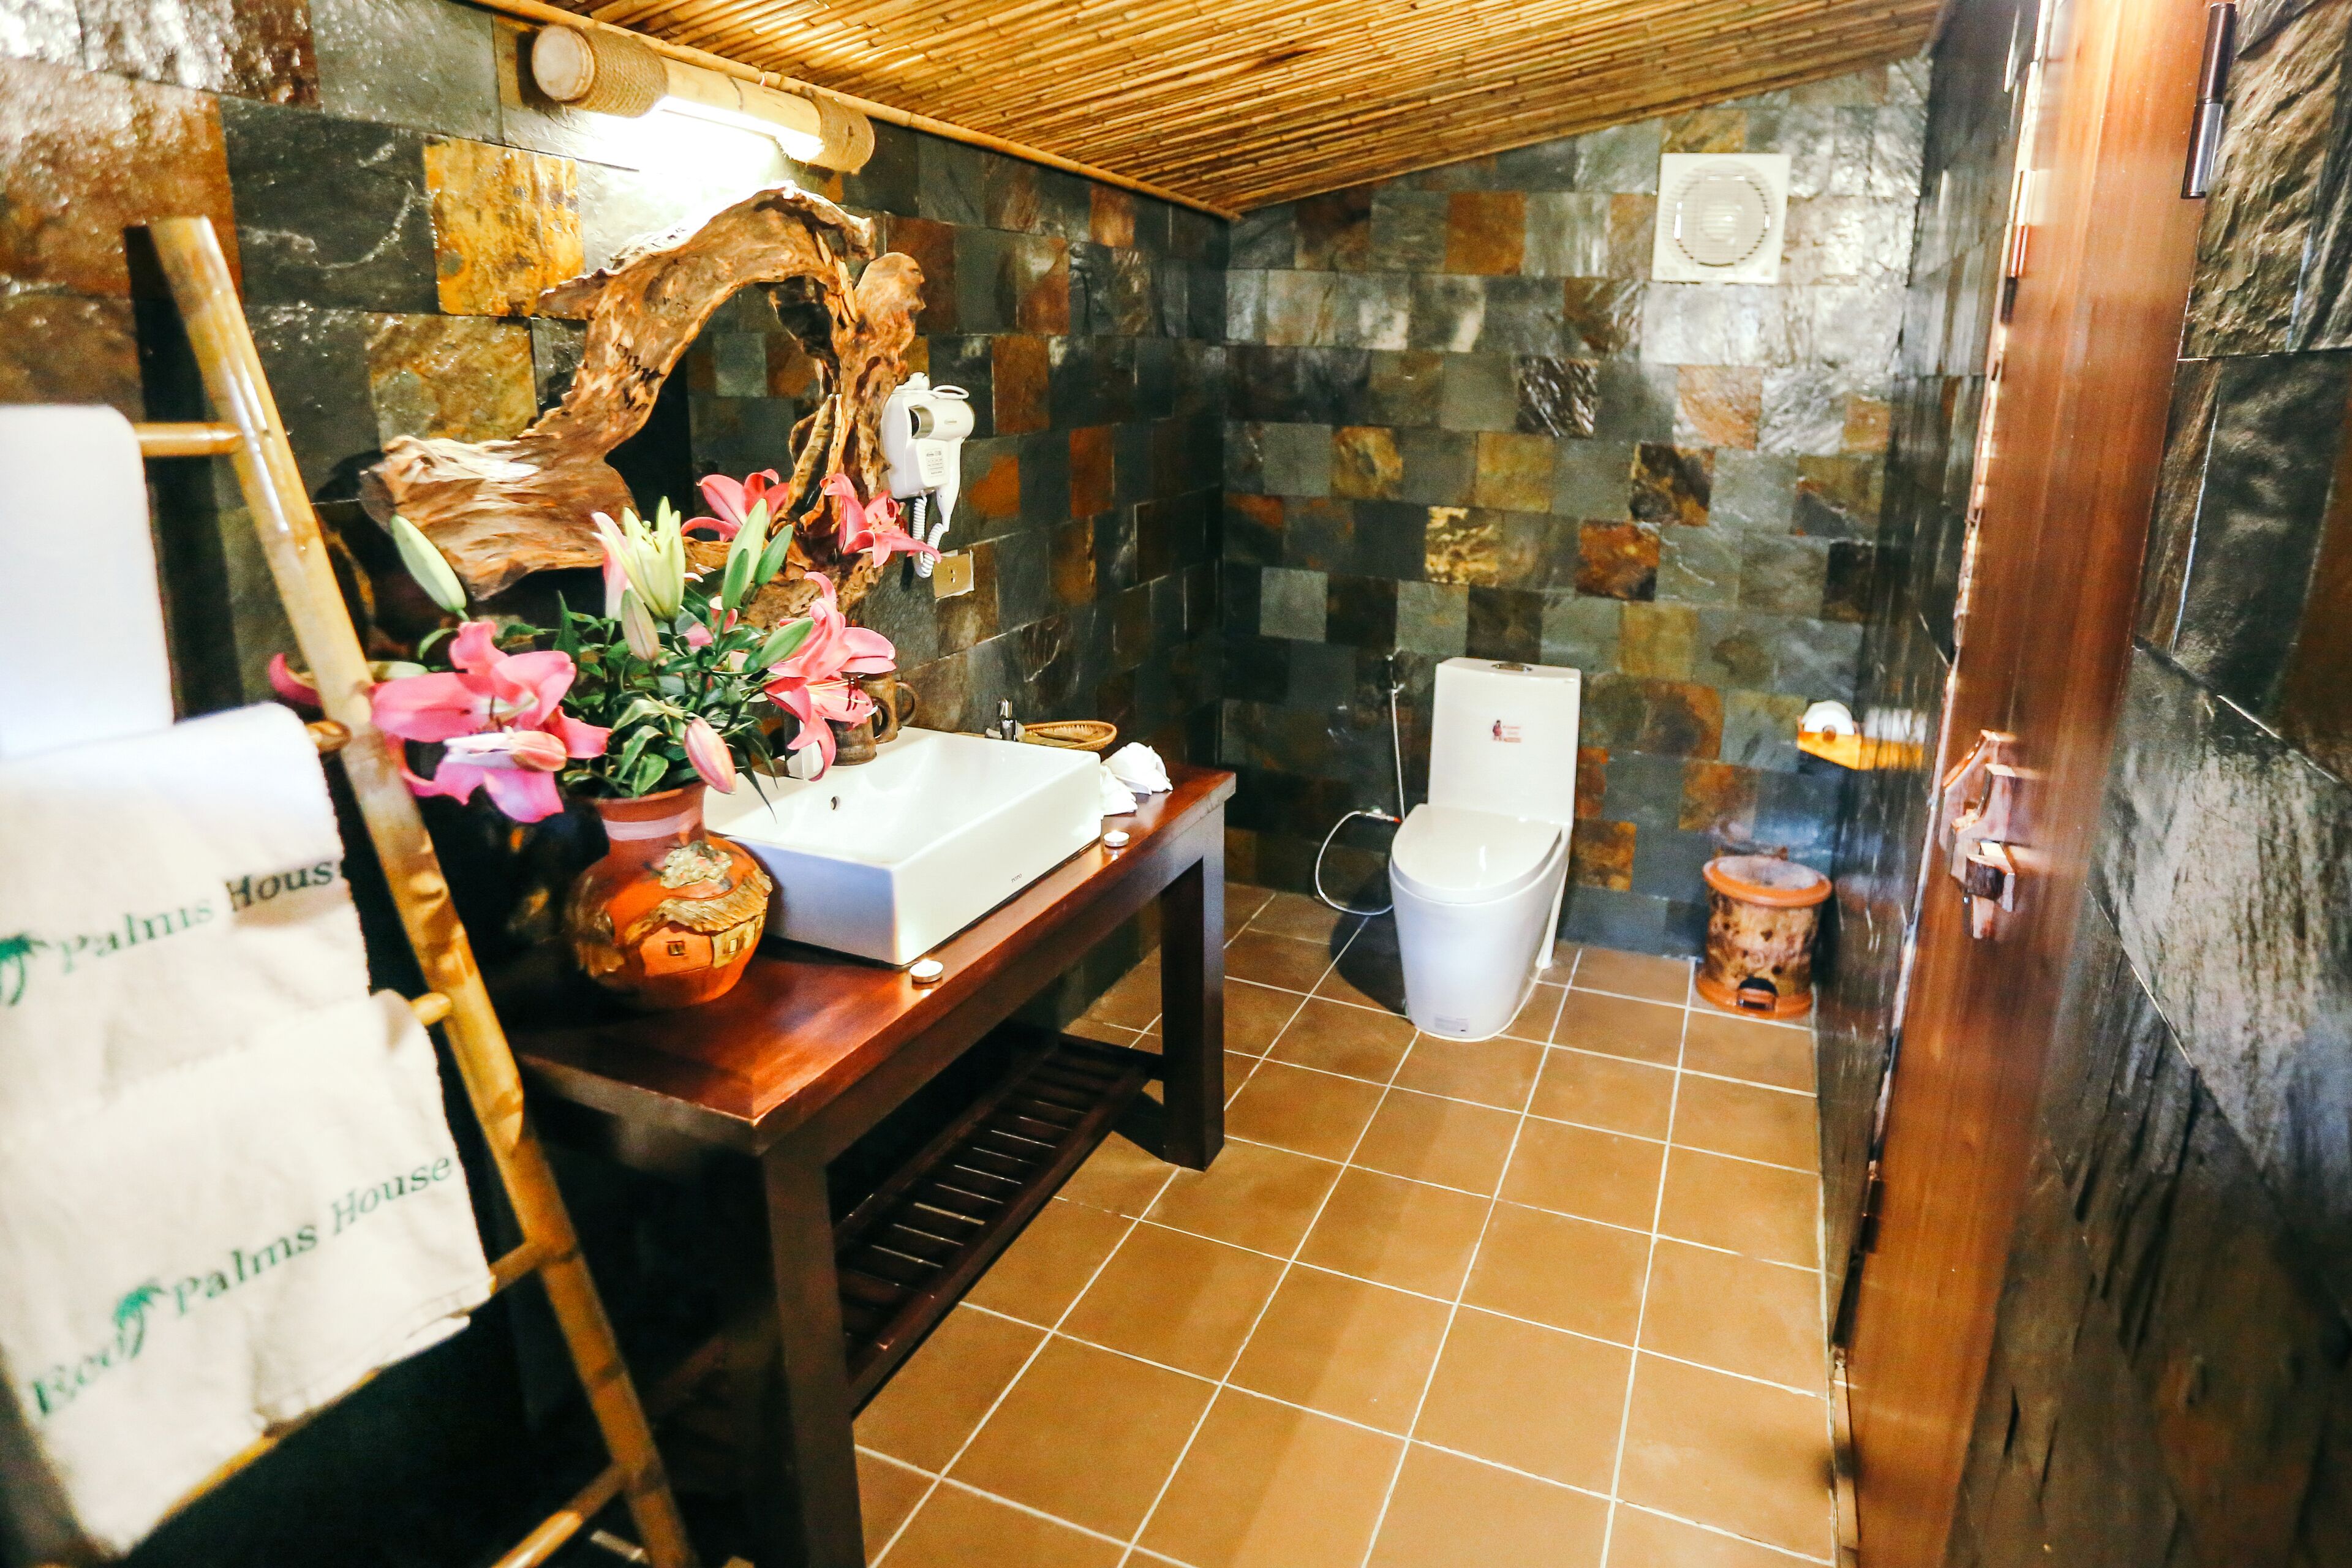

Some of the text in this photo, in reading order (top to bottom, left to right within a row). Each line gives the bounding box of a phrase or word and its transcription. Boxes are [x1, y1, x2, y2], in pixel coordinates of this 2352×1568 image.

[59, 859, 344, 975] Palms Hous
[174, 1224, 318, 1317] Palms
[331, 1156, 452, 1235] House
